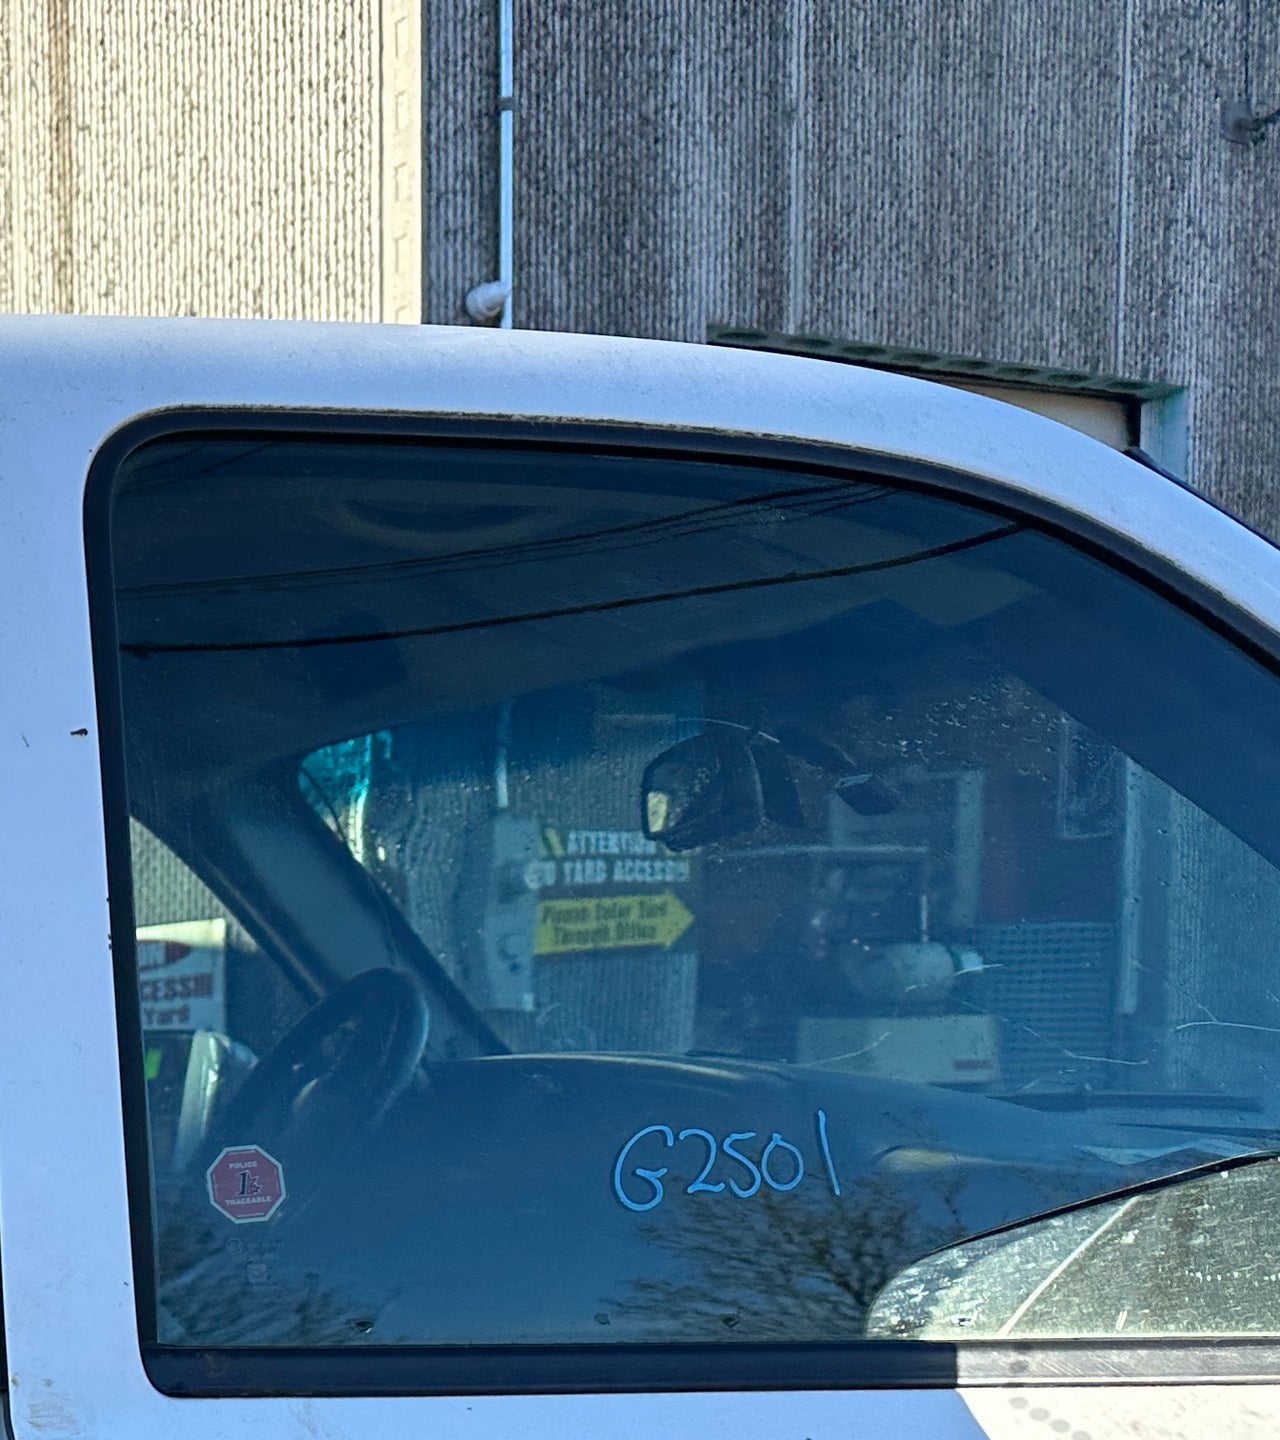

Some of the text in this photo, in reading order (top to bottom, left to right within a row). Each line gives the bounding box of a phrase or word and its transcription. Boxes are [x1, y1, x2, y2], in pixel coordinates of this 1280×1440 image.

[229, 1161, 258, 1169] POLICE
[614, 1109, 840, 1212] G2501
[225, 1195, 272, 1206] TRACEABLE
